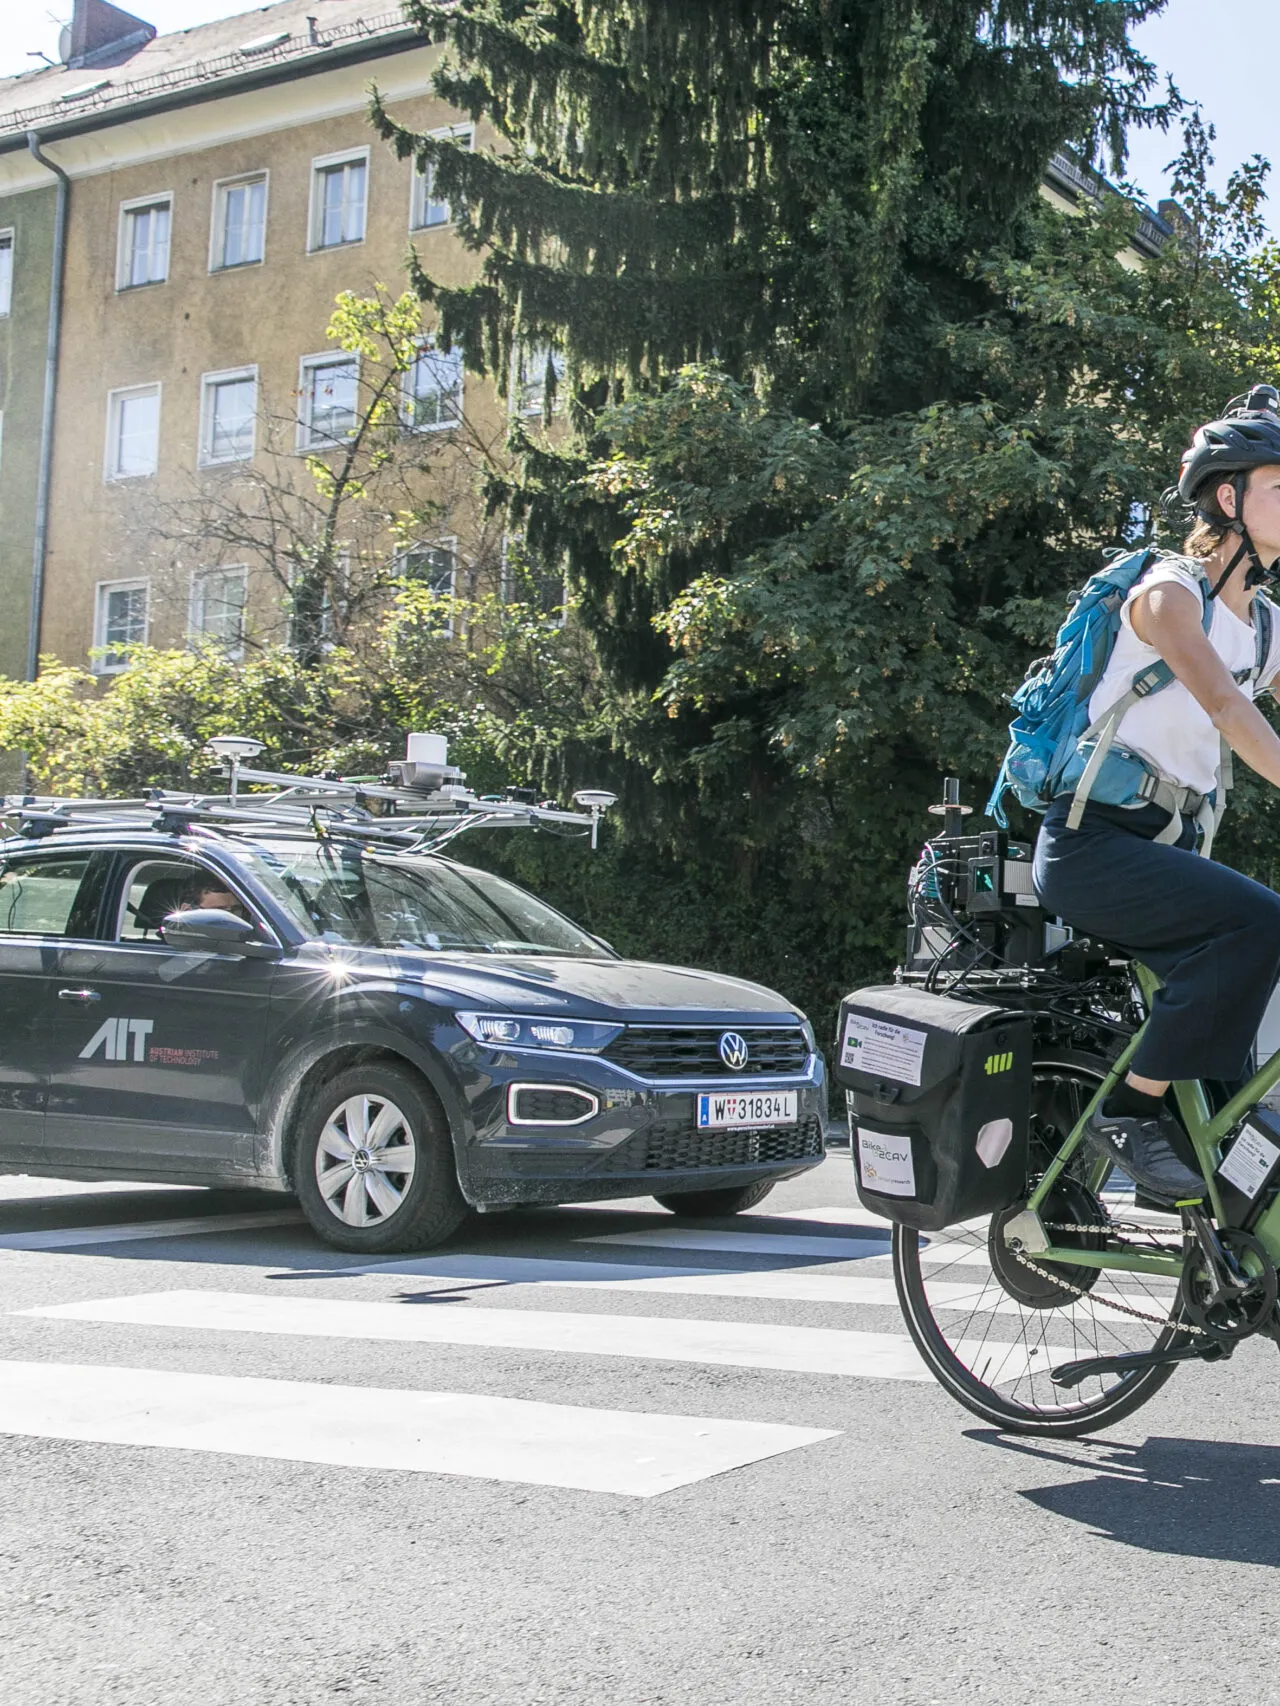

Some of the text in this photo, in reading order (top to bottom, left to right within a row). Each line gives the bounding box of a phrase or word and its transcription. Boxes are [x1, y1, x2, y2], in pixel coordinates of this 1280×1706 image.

[78, 1017, 154, 1062] AIT
[150, 1047, 219, 1059] AUSTRIAN INSTITUTE
[159, 1056, 201, 1066] TECHNOLOGY
[714, 1099, 727, 1121] W
